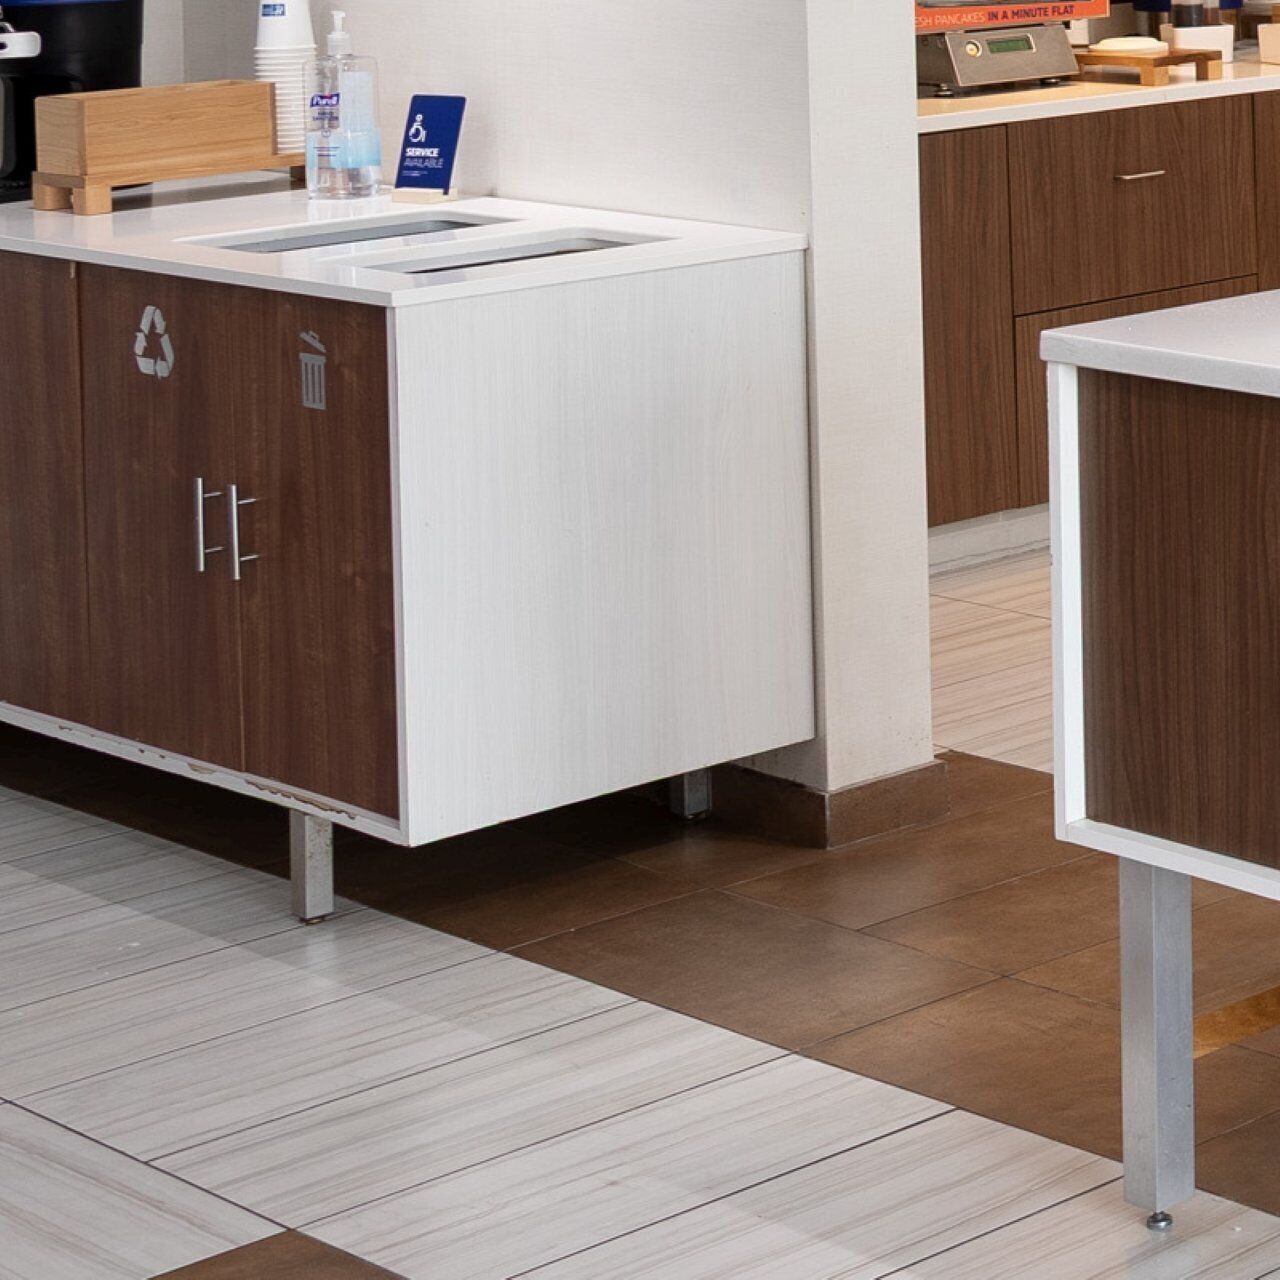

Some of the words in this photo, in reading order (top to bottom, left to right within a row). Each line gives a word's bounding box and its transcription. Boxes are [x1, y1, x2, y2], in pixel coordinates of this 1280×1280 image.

[987, 11, 999, 21] IN
[1002, 10, 1009, 20] A
[1011, 7, 1049, 19] MINUTE
[1051, 5, 1075, 16] FLAT
[405, 148, 440, 157] SERVICE
[403, 157, 444, 168] AVAILABLE
